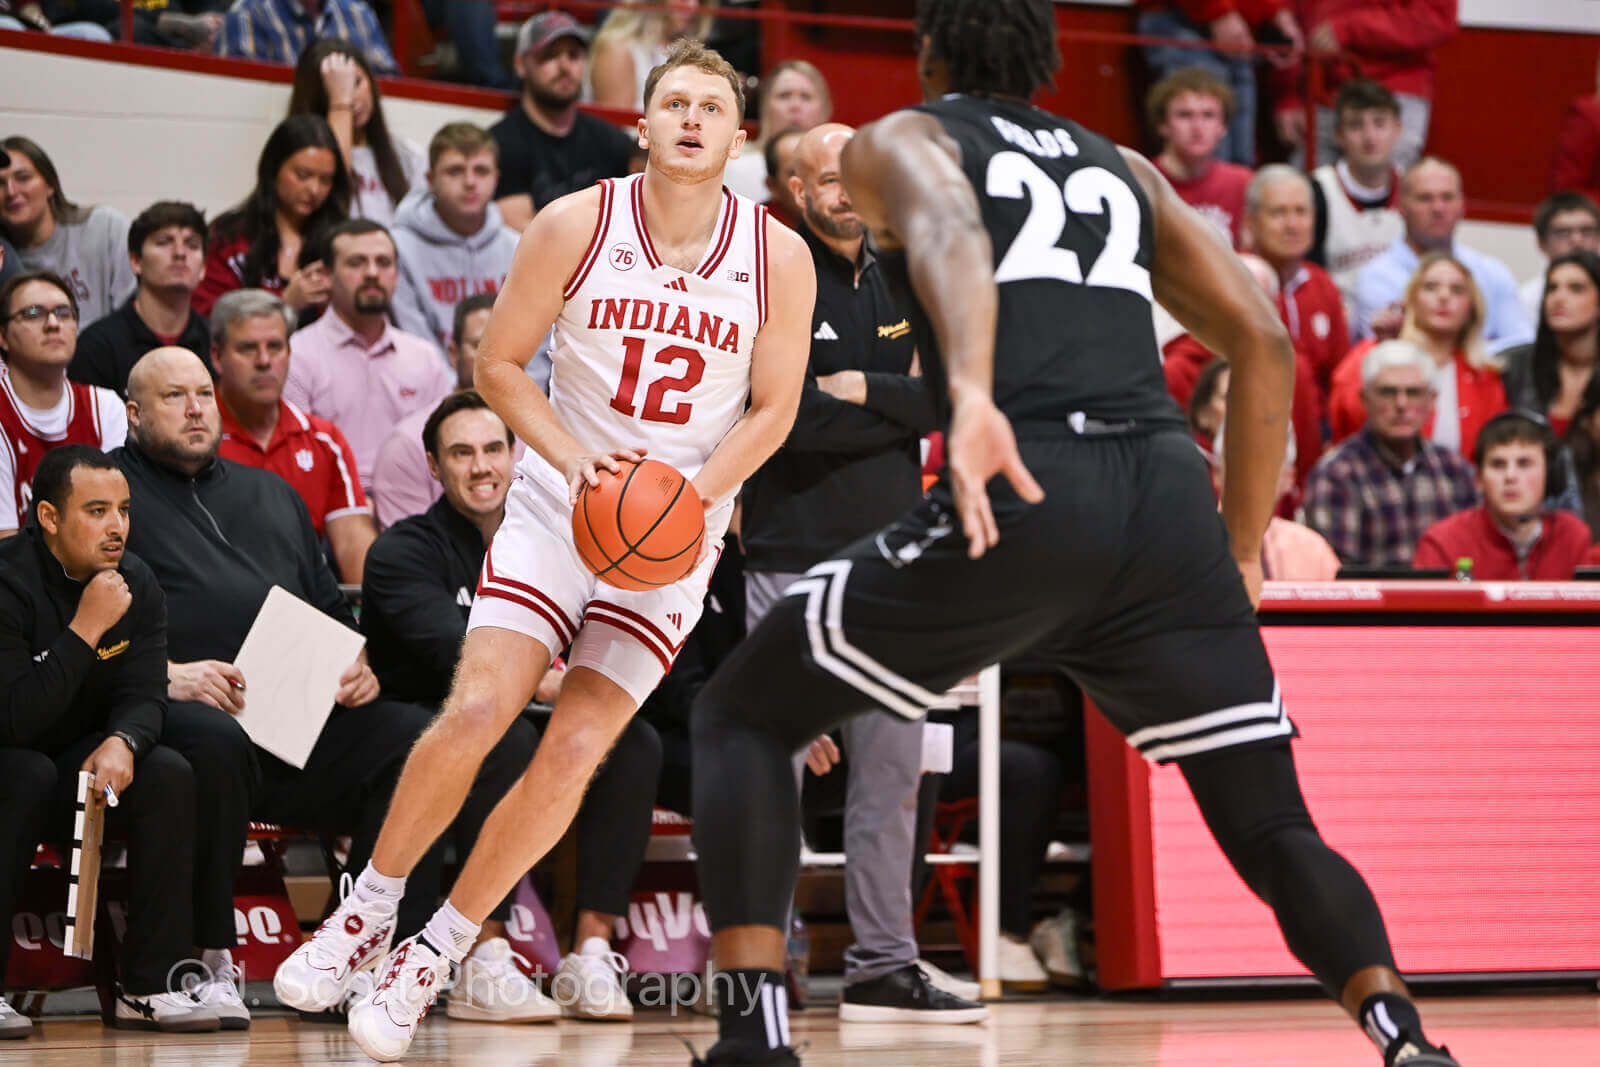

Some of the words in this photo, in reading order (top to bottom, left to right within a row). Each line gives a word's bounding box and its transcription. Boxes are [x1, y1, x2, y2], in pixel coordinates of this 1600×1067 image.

[985, 151, 1154, 303] 22
[587, 298, 740, 354] INDIANA
[609, 336, 706, 425] 12
